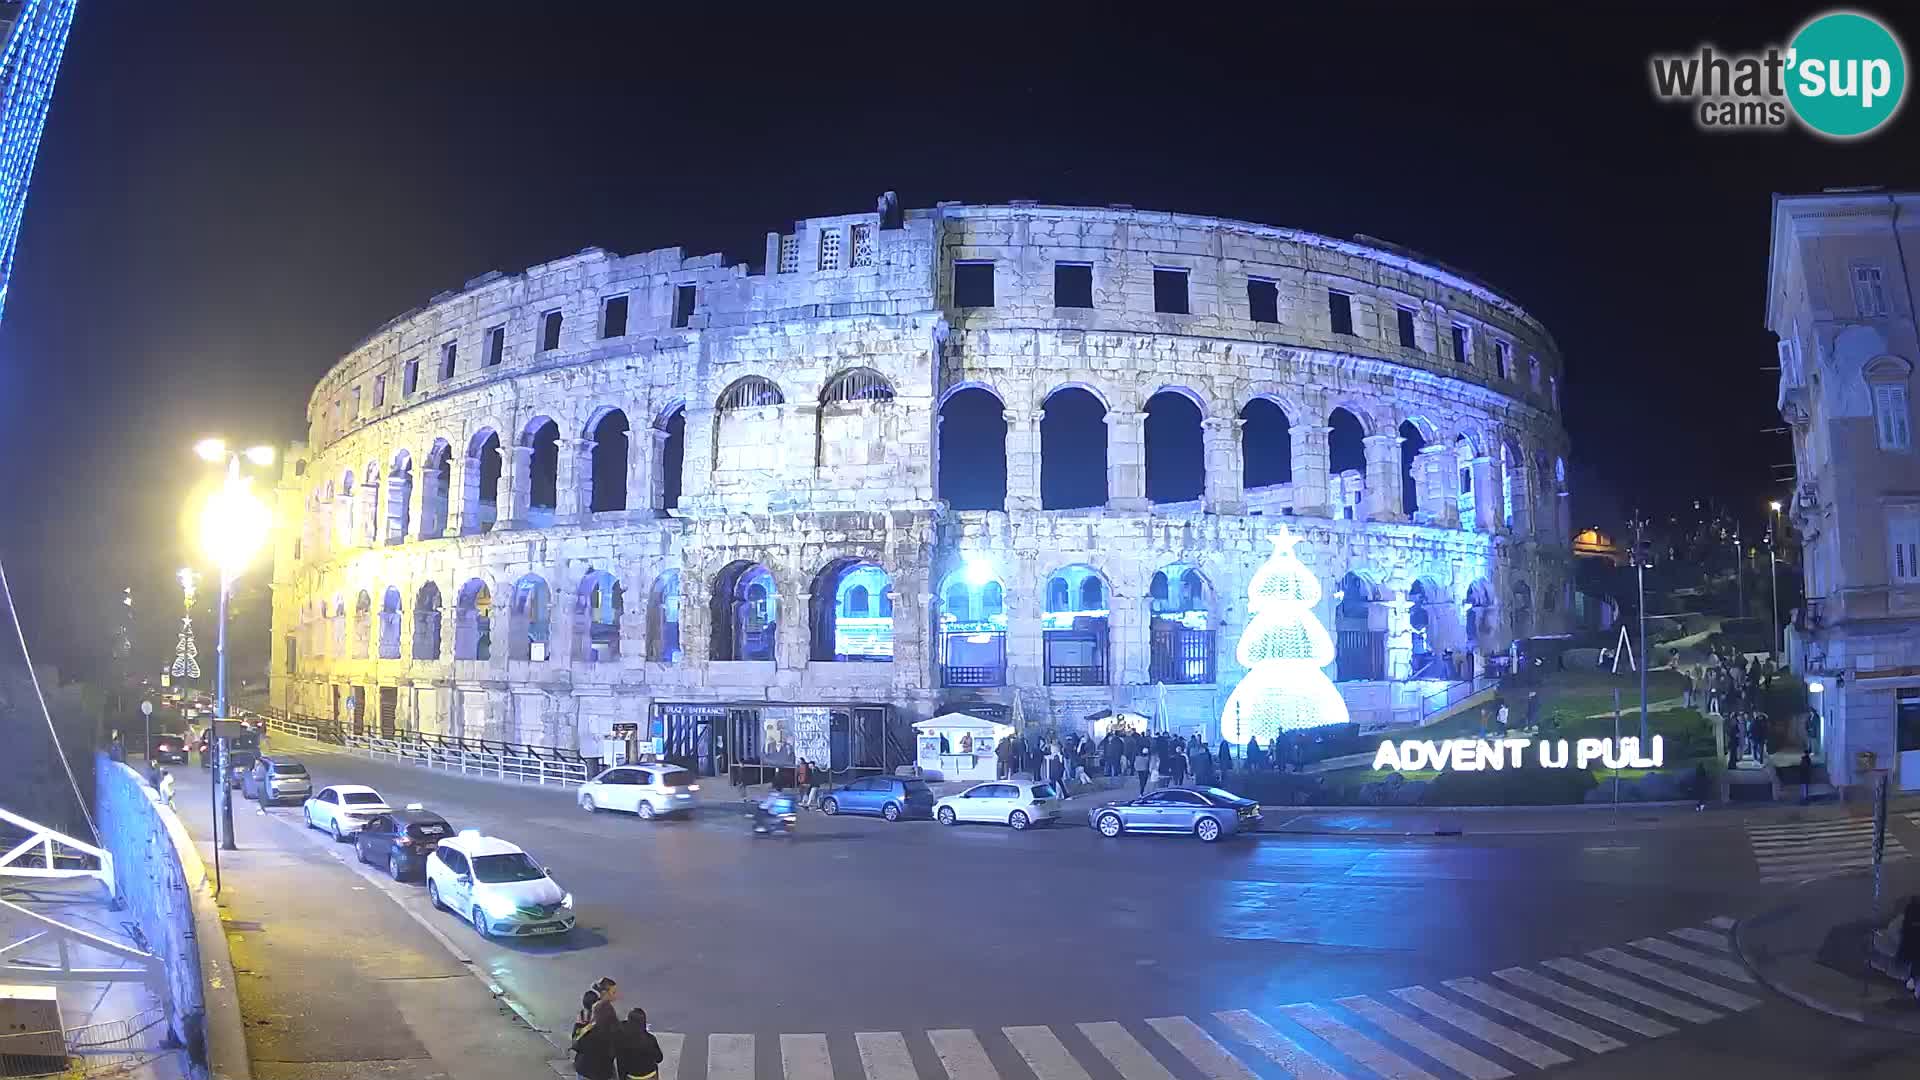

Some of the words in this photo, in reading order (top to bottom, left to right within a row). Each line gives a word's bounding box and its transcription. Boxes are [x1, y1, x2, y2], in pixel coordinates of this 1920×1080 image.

[1372, 739, 1531, 771] ADVENT
[1539, 739, 1568, 769] U
[1577, 735, 1664, 770] PULI
